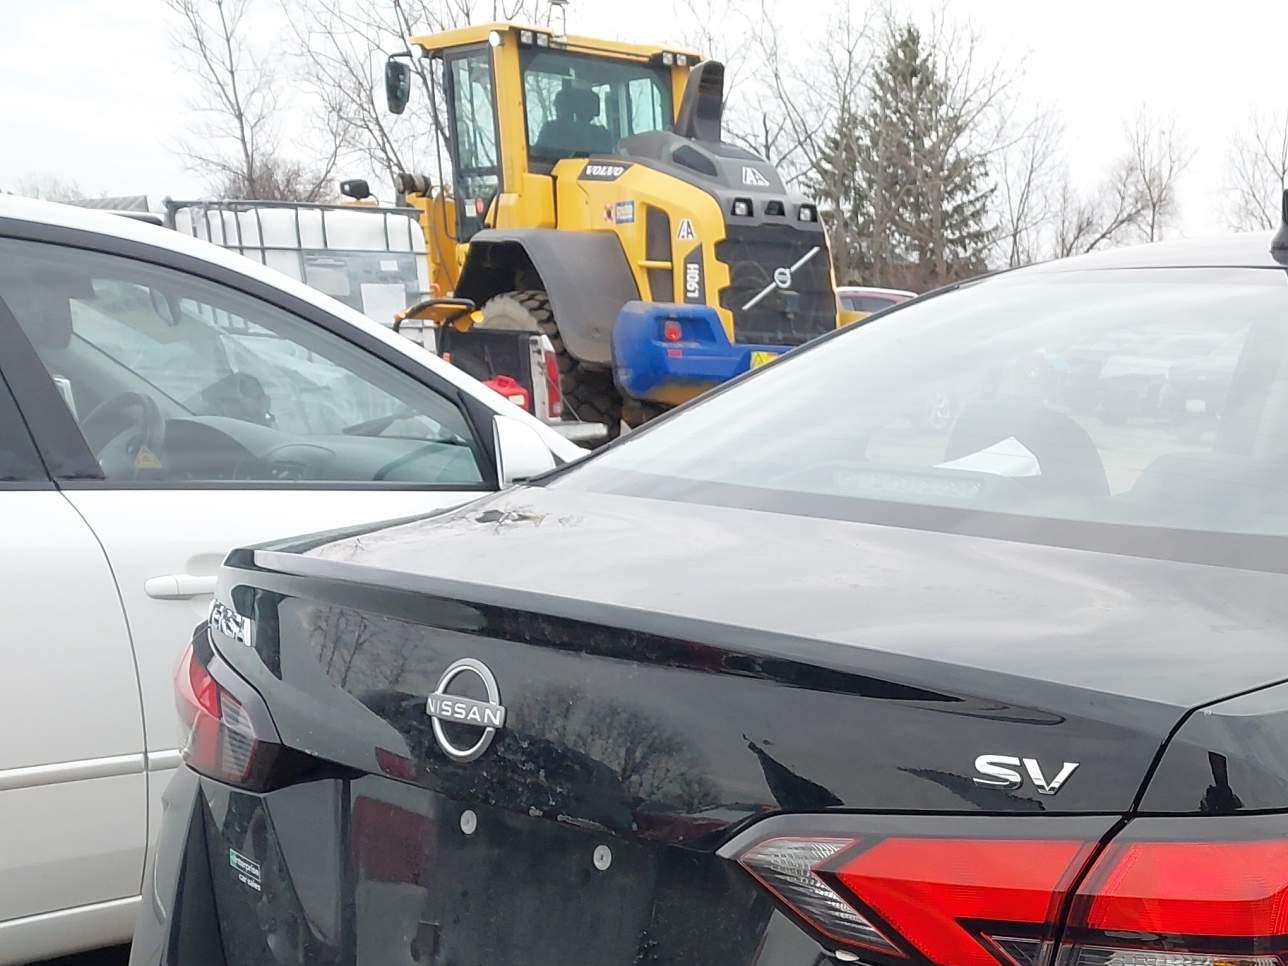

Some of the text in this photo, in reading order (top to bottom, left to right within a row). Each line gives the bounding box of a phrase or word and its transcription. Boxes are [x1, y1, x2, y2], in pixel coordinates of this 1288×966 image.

[585, 165, 625, 177] VOLVO
[686, 263, 700, 298] L90H
[427, 698, 501, 726] NISSAN
[973, 754, 1080, 795] SV
